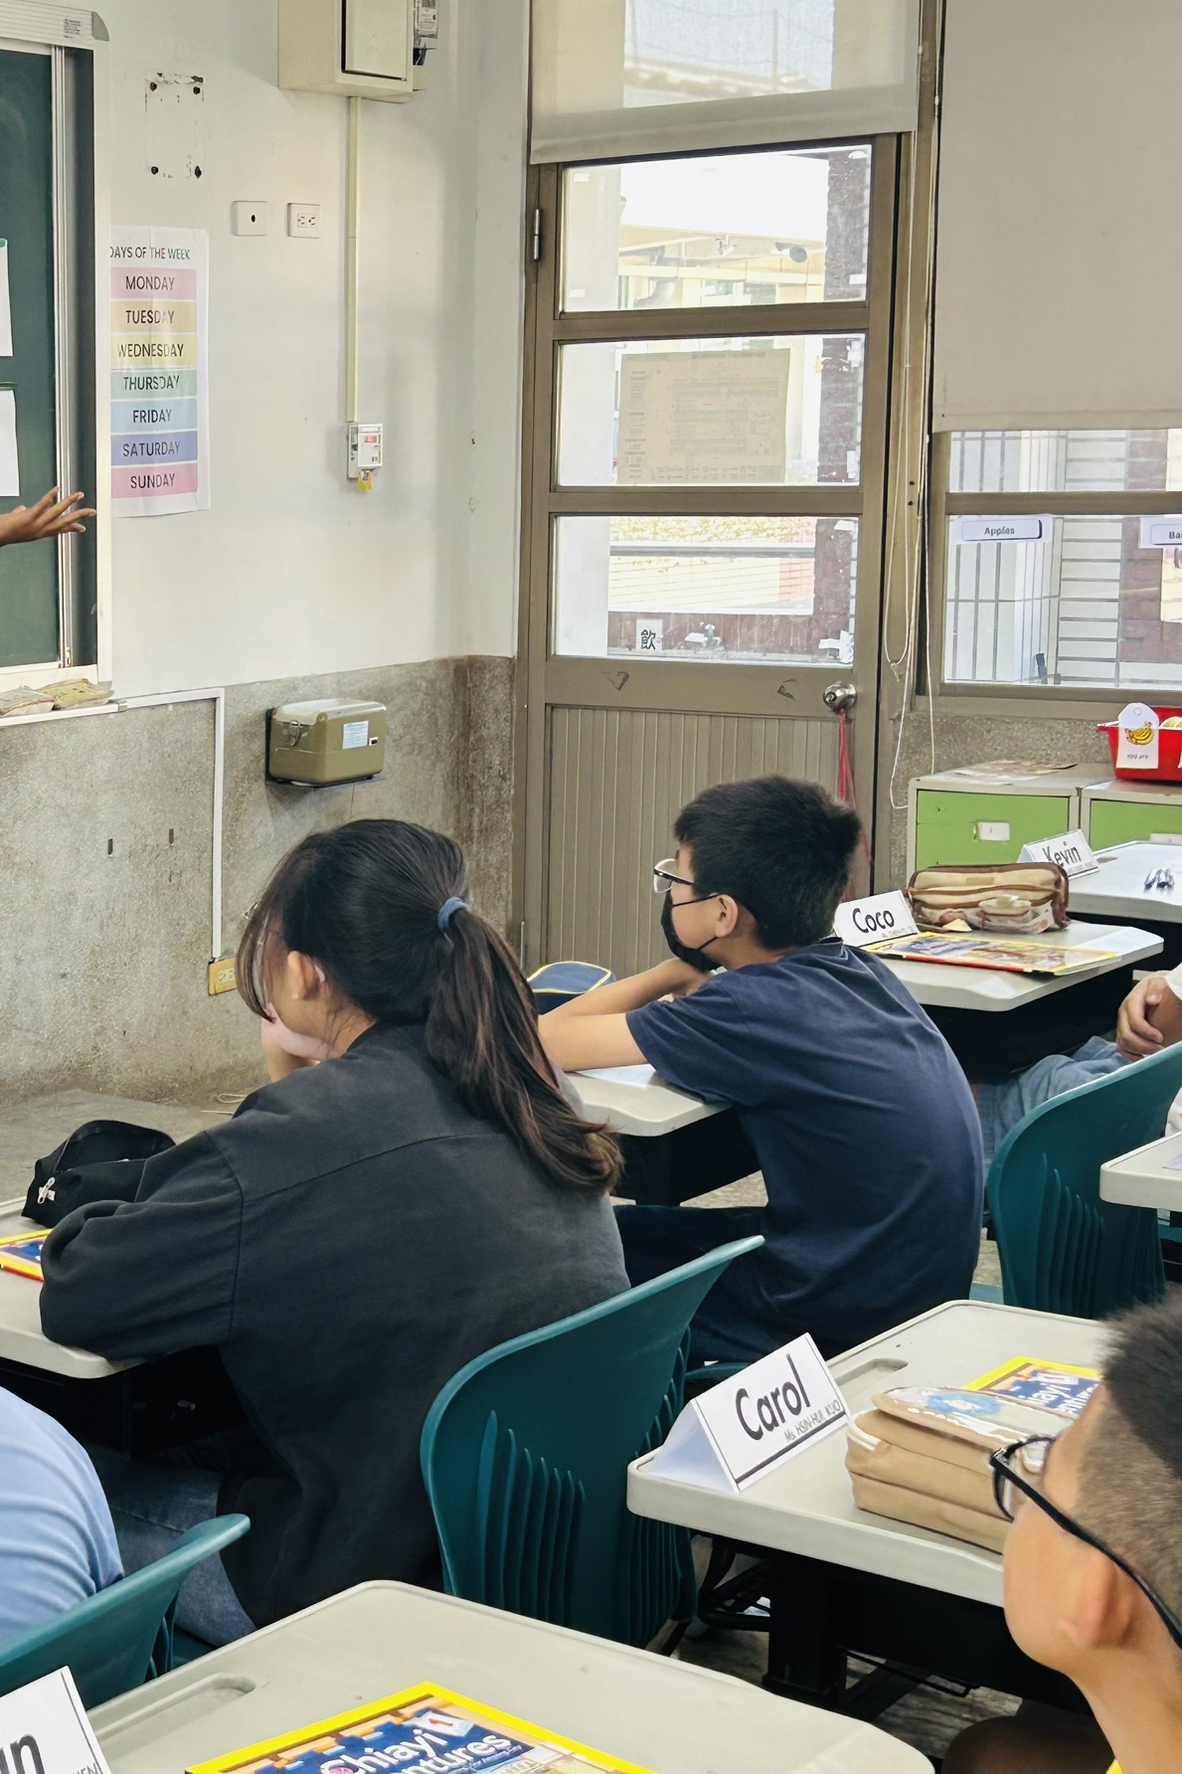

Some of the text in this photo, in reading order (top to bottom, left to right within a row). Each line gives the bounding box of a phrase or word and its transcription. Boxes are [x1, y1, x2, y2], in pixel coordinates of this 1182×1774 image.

[135, 246, 147, 259] OF
[149, 247, 166, 260] THE
[167, 248, 191, 260] WEEK
[125, 275, 175, 291] MONDAY
[125, 309, 175, 324] TUESDAY
[117, 343, 184, 357] WEDNESDAY
[123, 375, 180, 391] THURSDAY
[132, 408, 172, 423] FRIDAY
[122, 441, 181, 457] SATURDAY
[130, 473, 175, 489] SUNDAY
[984, 526, 1015, 536] Apples
[640, 629, 656, 650] 飲
[1042, 841, 1082, 868] Kevin
[852, 907, 896, 934] Coco
[735, 1353, 811, 1441] Carol
